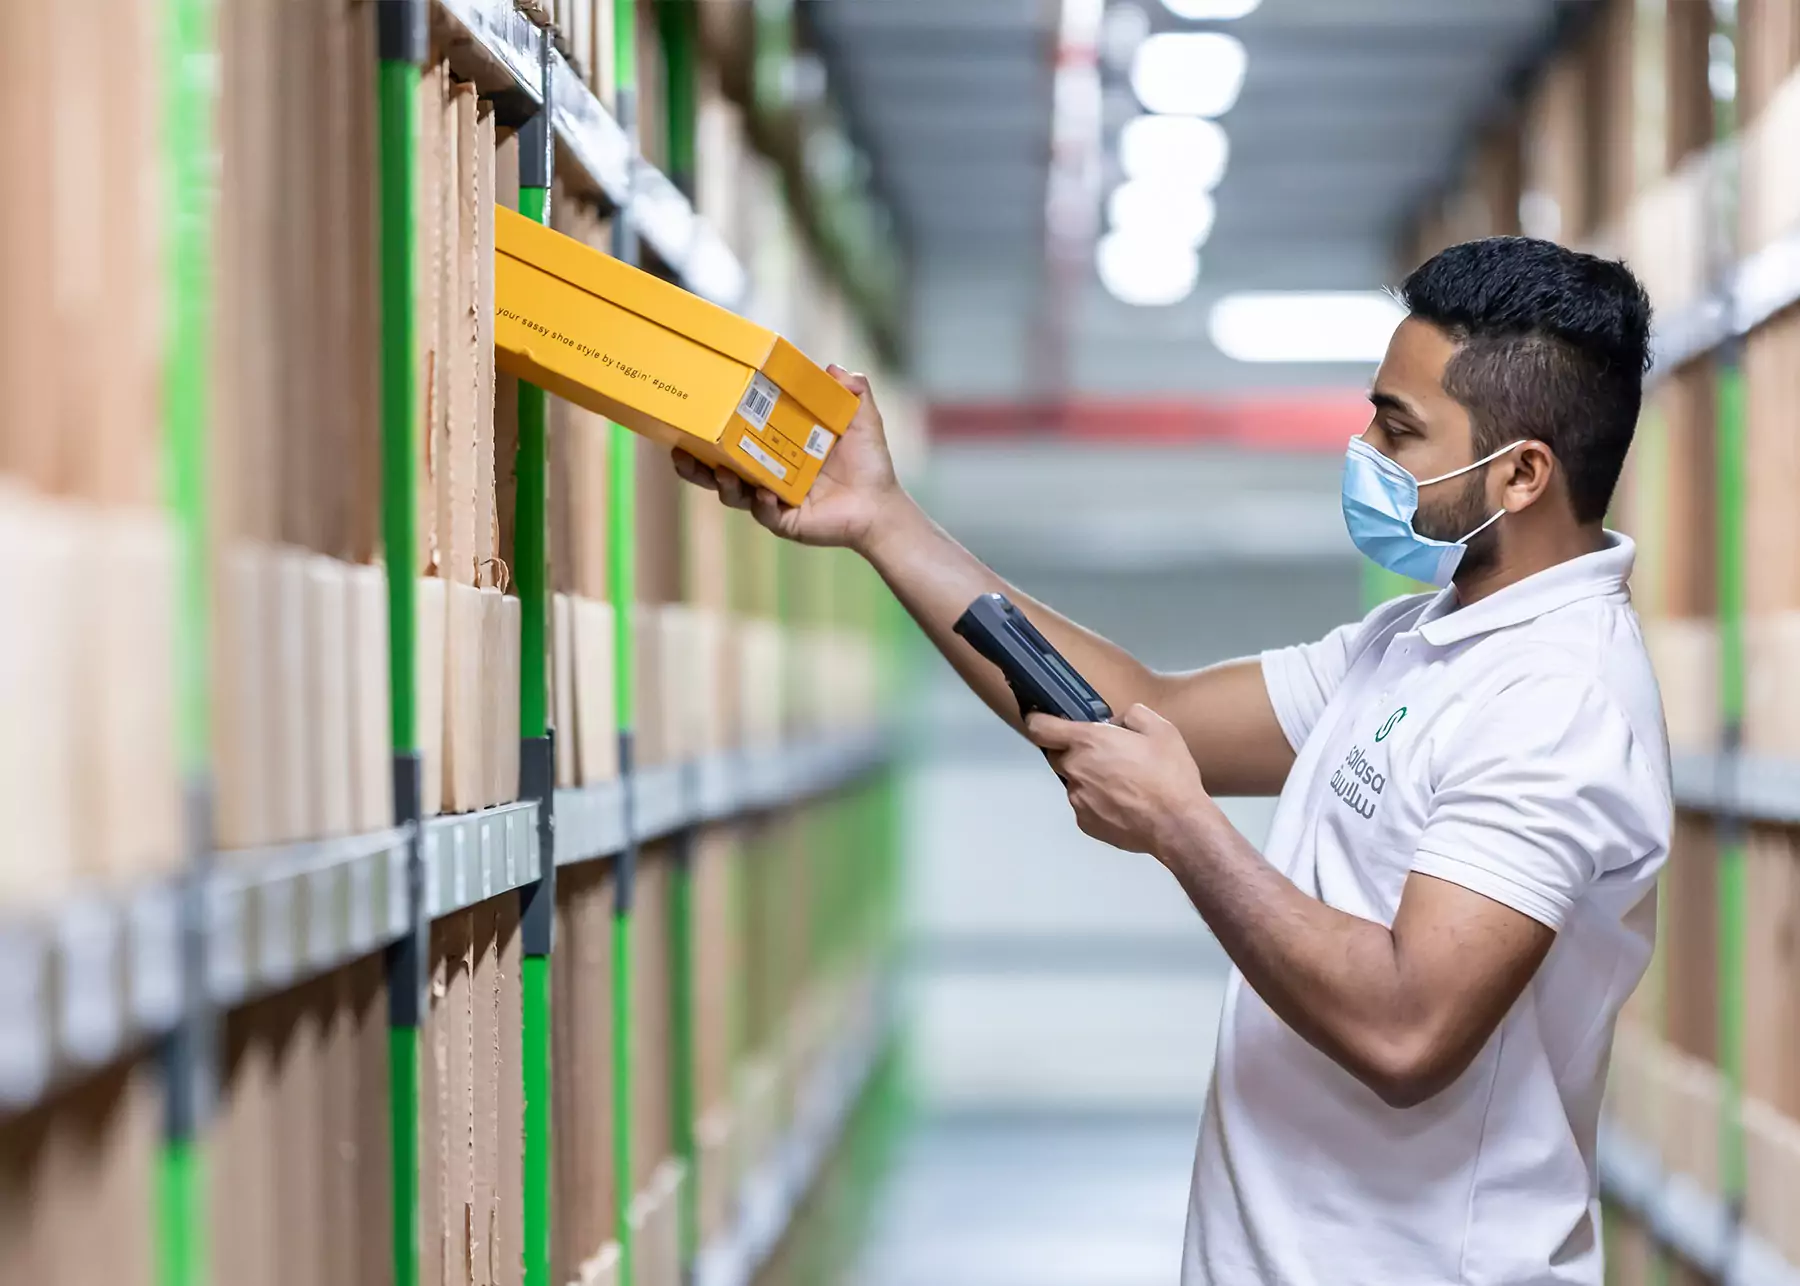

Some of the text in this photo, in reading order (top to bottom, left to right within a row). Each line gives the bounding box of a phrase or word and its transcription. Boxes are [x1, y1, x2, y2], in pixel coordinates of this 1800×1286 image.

[496, 307, 520, 322] your
[521, 318, 550, 337] sassy
[551, 332, 575, 347] shoe
[576, 343, 601, 359] style
[601, 353, 615, 367] by
[652, 379, 689, 400] #pdbae
